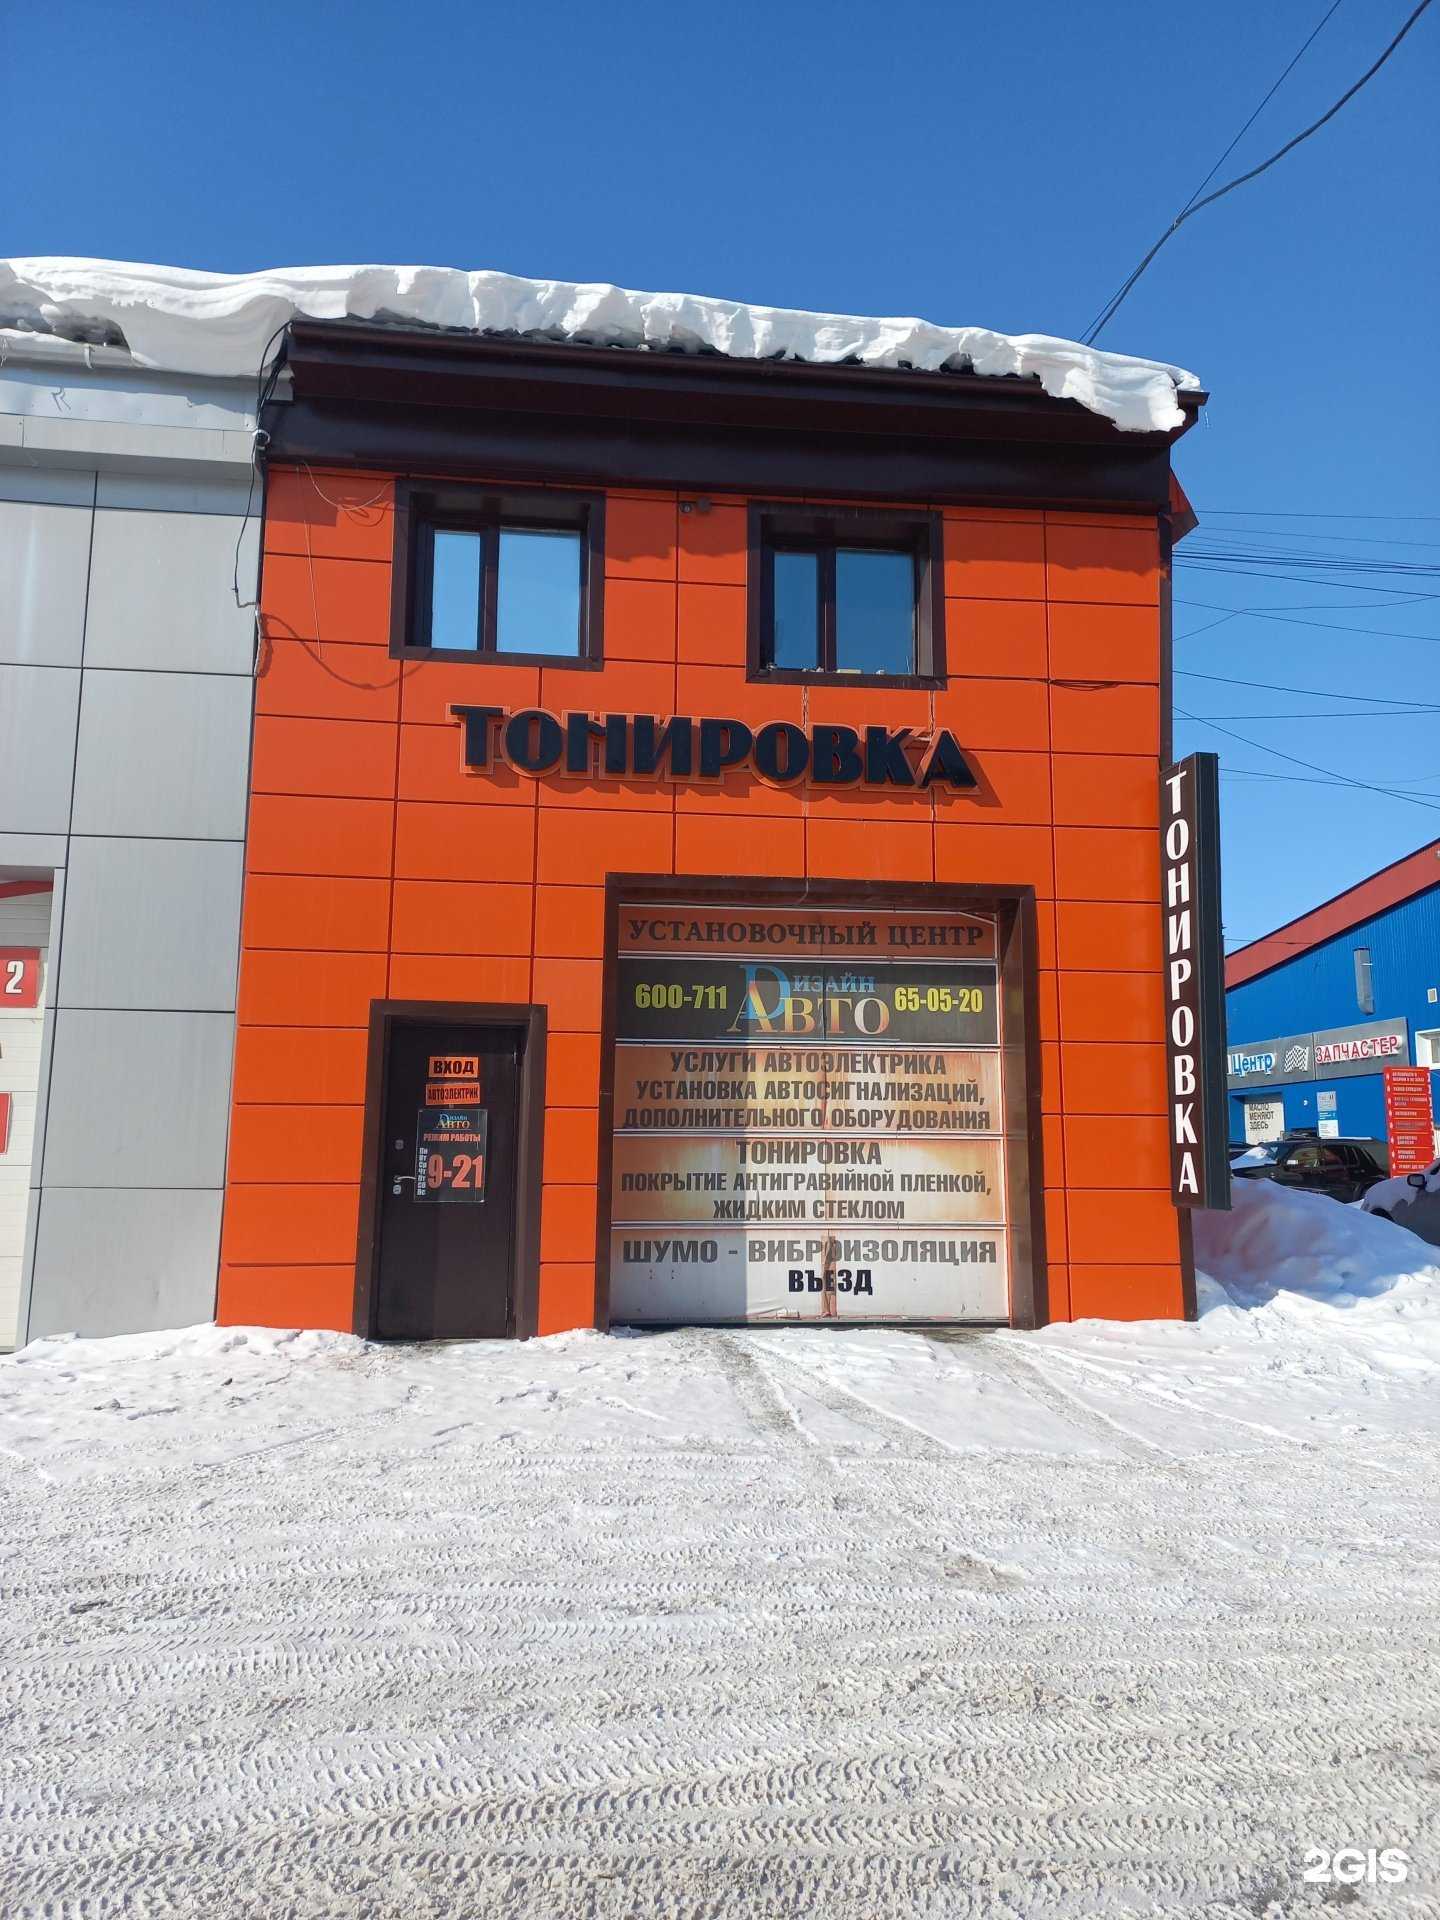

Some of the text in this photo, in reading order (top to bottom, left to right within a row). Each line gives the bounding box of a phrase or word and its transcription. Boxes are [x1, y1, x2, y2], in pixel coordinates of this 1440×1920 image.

[447, 702, 981, 794] ТОНИРОВКА
[629, 920, 984, 948] УСТАНОВОЧНЫЙ ЦЕНТР
[5, 960, 24, 994] 2
[1165, 771, 1200, 1194] ТОНИРОВКА
[635, 984, 727, 1008] 600-711
[727, 981, 890, 1035] АВТО
[895, 987, 983, 1012] 65-05-20
[1315, 1036, 1398, 1063] ЗАПЧАСТЕР
[434, 1060, 474, 1074] ВХОД
[671, 1052, 946, 1074] УСЛУГИ АВТОЭЛЕКТРИКА
[1232, 1054, 1273, 1074] Центр
[428, 1087, 478, 1100] АВТОЭЛЕКТРИК
[636, 1079, 985, 1105] УСТАНОВКА АВТОСИГНАЛИЗАЦИЙ,
[624, 1108, 990, 1131] ДОПОЛНИТЕЛЬНОГО ОБОРУДОВАНИЯ
[1249, 1111, 1274, 1120] МЕНЯЮТ
[1249, 1121, 1269, 1130] ЗДЕСЬ
[736, 1141, 881, 1165] ТОНИРОВКА
[428, 1154, 483, 1188] 9-21
[621, 1169, 991, 1195] ПОКРЫТИЕ АНТИГРАВИЙНОЙ ПЛЕНКОЙ,
[714, 1200, 904, 1221] ЖИДКИМ СТЕКЛОМ
[623, 1240, 718, 1263] ШУМО
[748, 1240, 996, 1264] ВИБРОИЗОЛЯЦИЯ
[789, 1269, 873, 1295] ВЪЕЗД
